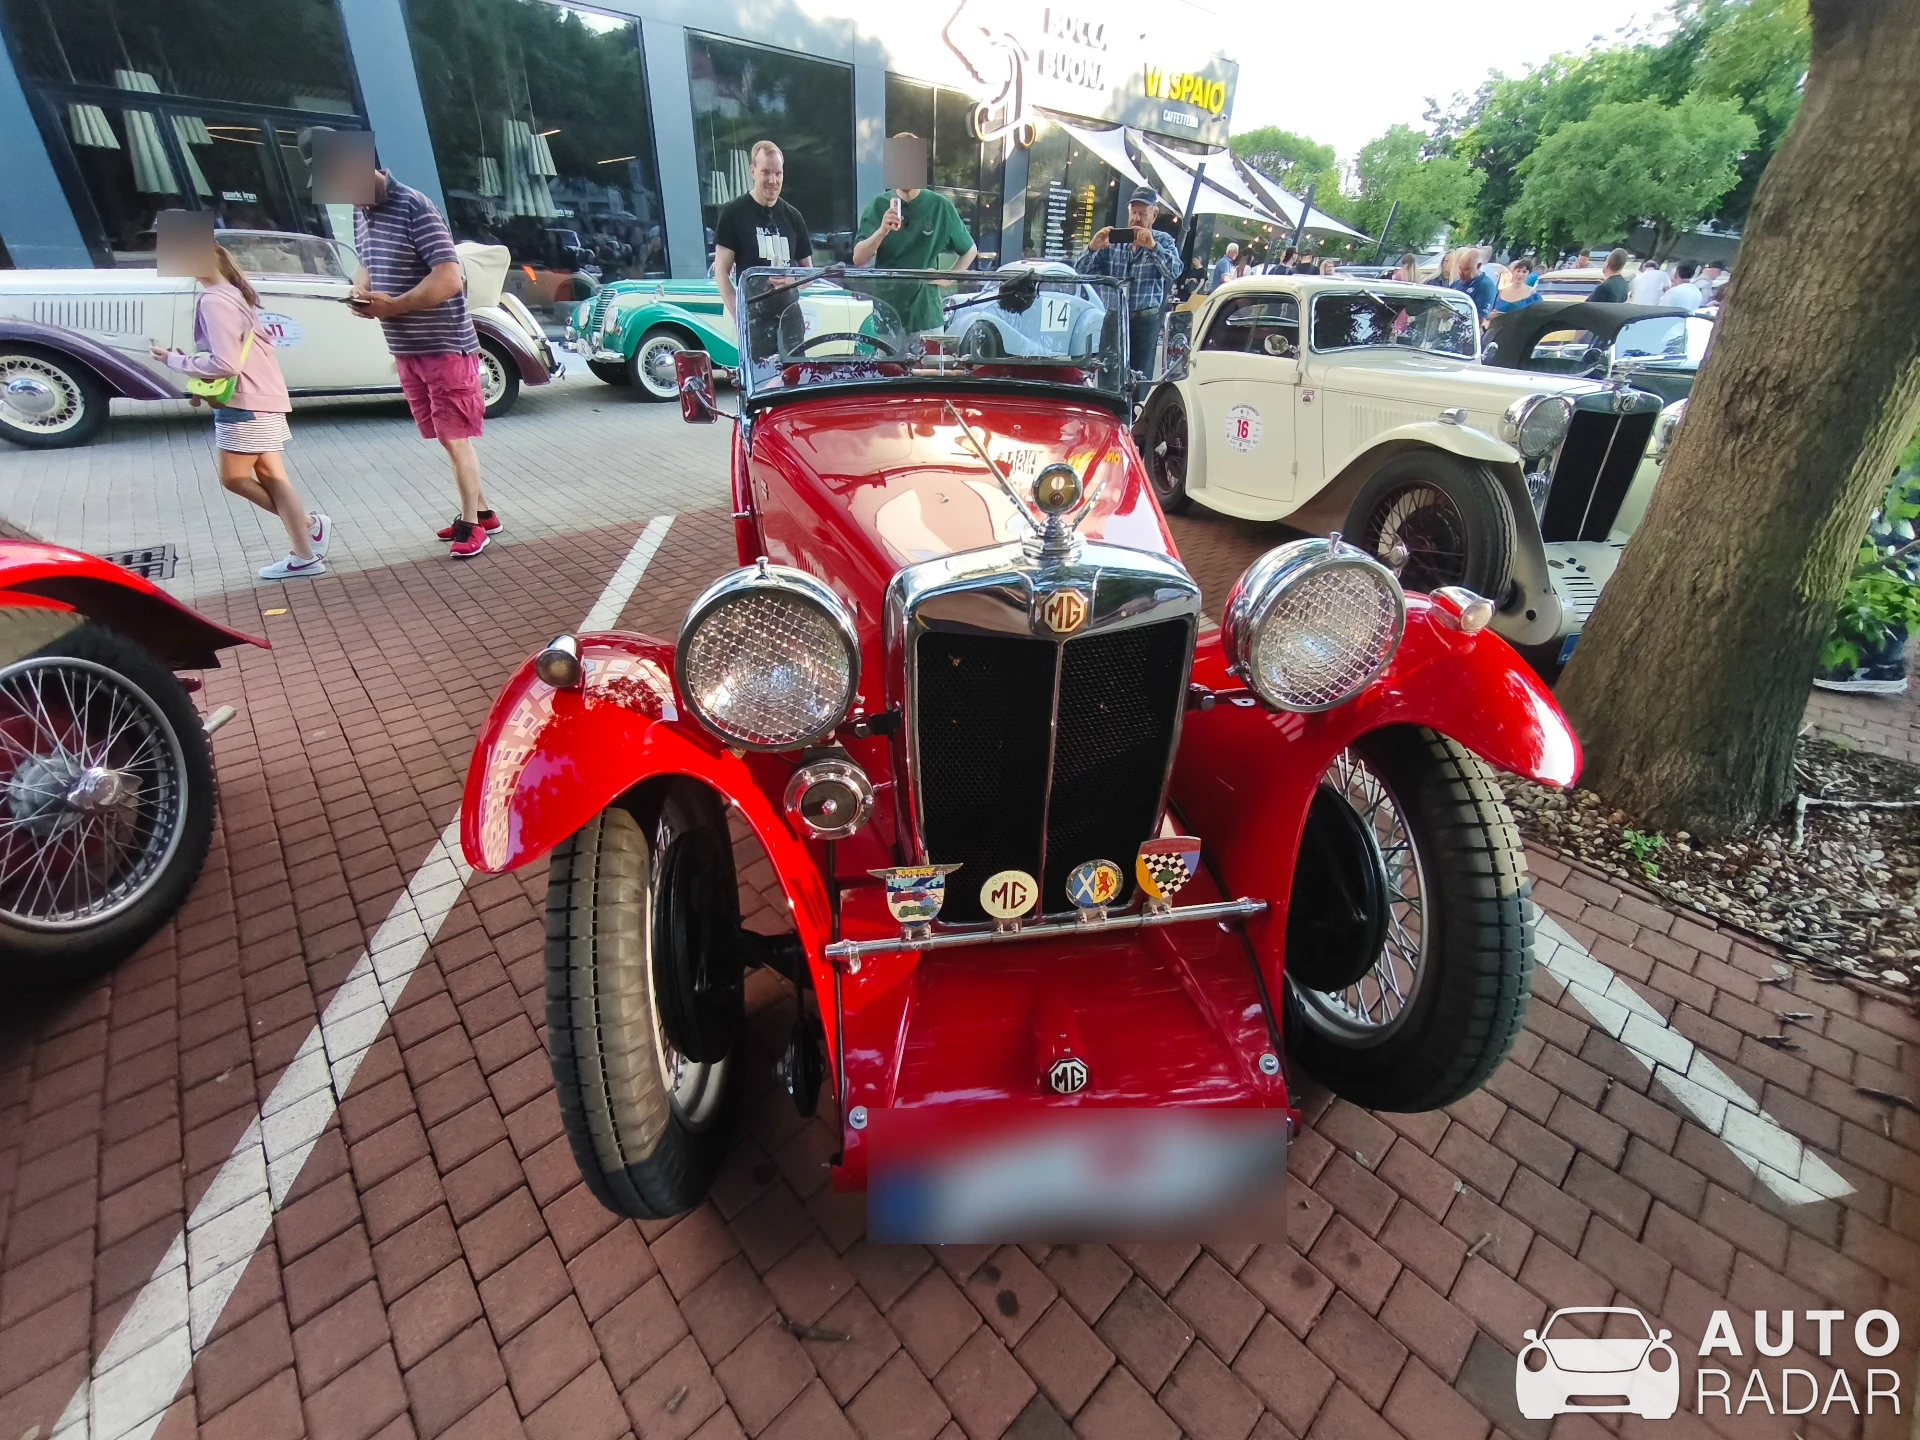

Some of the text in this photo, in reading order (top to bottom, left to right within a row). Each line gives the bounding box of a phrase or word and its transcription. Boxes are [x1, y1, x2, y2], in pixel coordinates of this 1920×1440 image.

[756, 226, 781, 236] BLAK
[1046, 299, 1069, 329] 14
[1237, 419, 1249, 439] 16
[1046, 594, 1083, 630] MG
[991, 873, 1029, 885] OWNERS
[991, 881, 1028, 910] MG
[1053, 1064, 1085, 1093] MG
